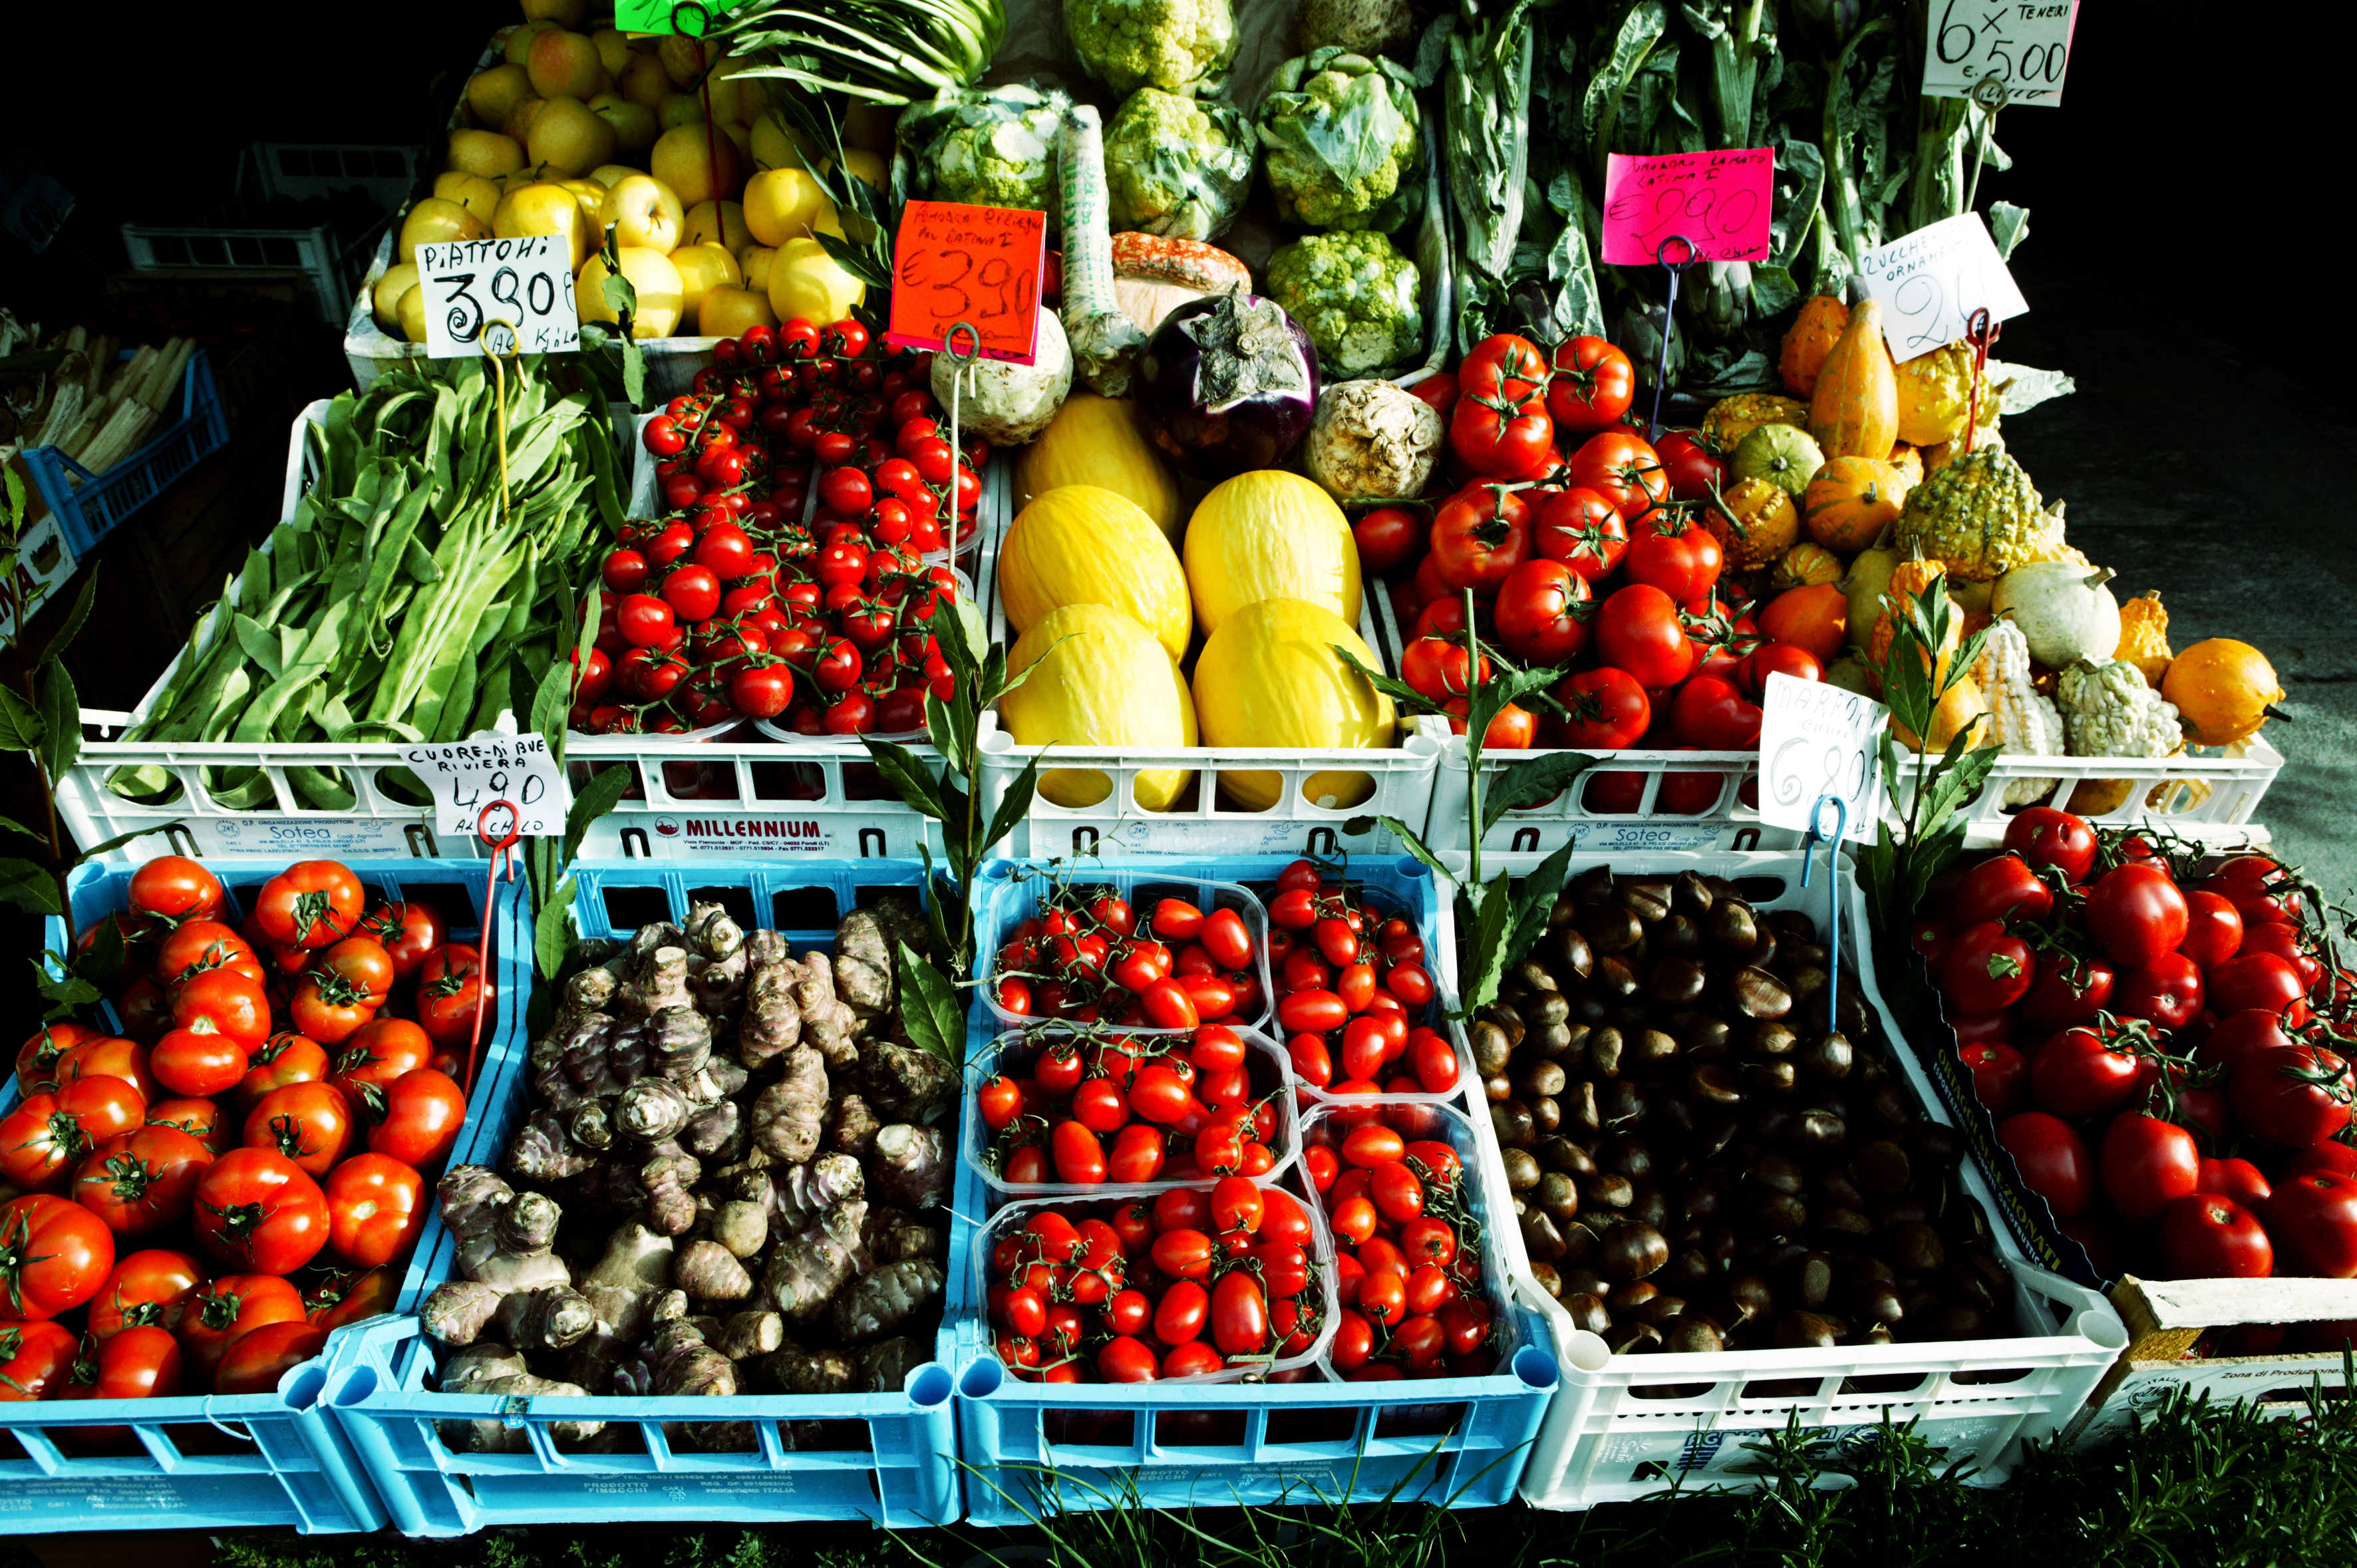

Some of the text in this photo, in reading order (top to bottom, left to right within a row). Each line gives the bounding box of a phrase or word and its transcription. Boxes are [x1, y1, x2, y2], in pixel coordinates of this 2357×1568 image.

[2018, 4, 2068, 20] TENERI
[1937, 0, 1976, 64] 6
[516, 739, 545, 756] BUE
[438, 757, 526, 772] RIVIERA
[269, 826, 331, 839] Sotea
[686, 820, 821, 838] MILLENNIUM
[1615, 828, 1671, 842] Sotea
[1938, 1048, 1978, 1134] ORTAGGI
[1978, 1134, 2061, 1271] SELEZIONATI
[2147, 1376, 2181, 1385] ITALIA
